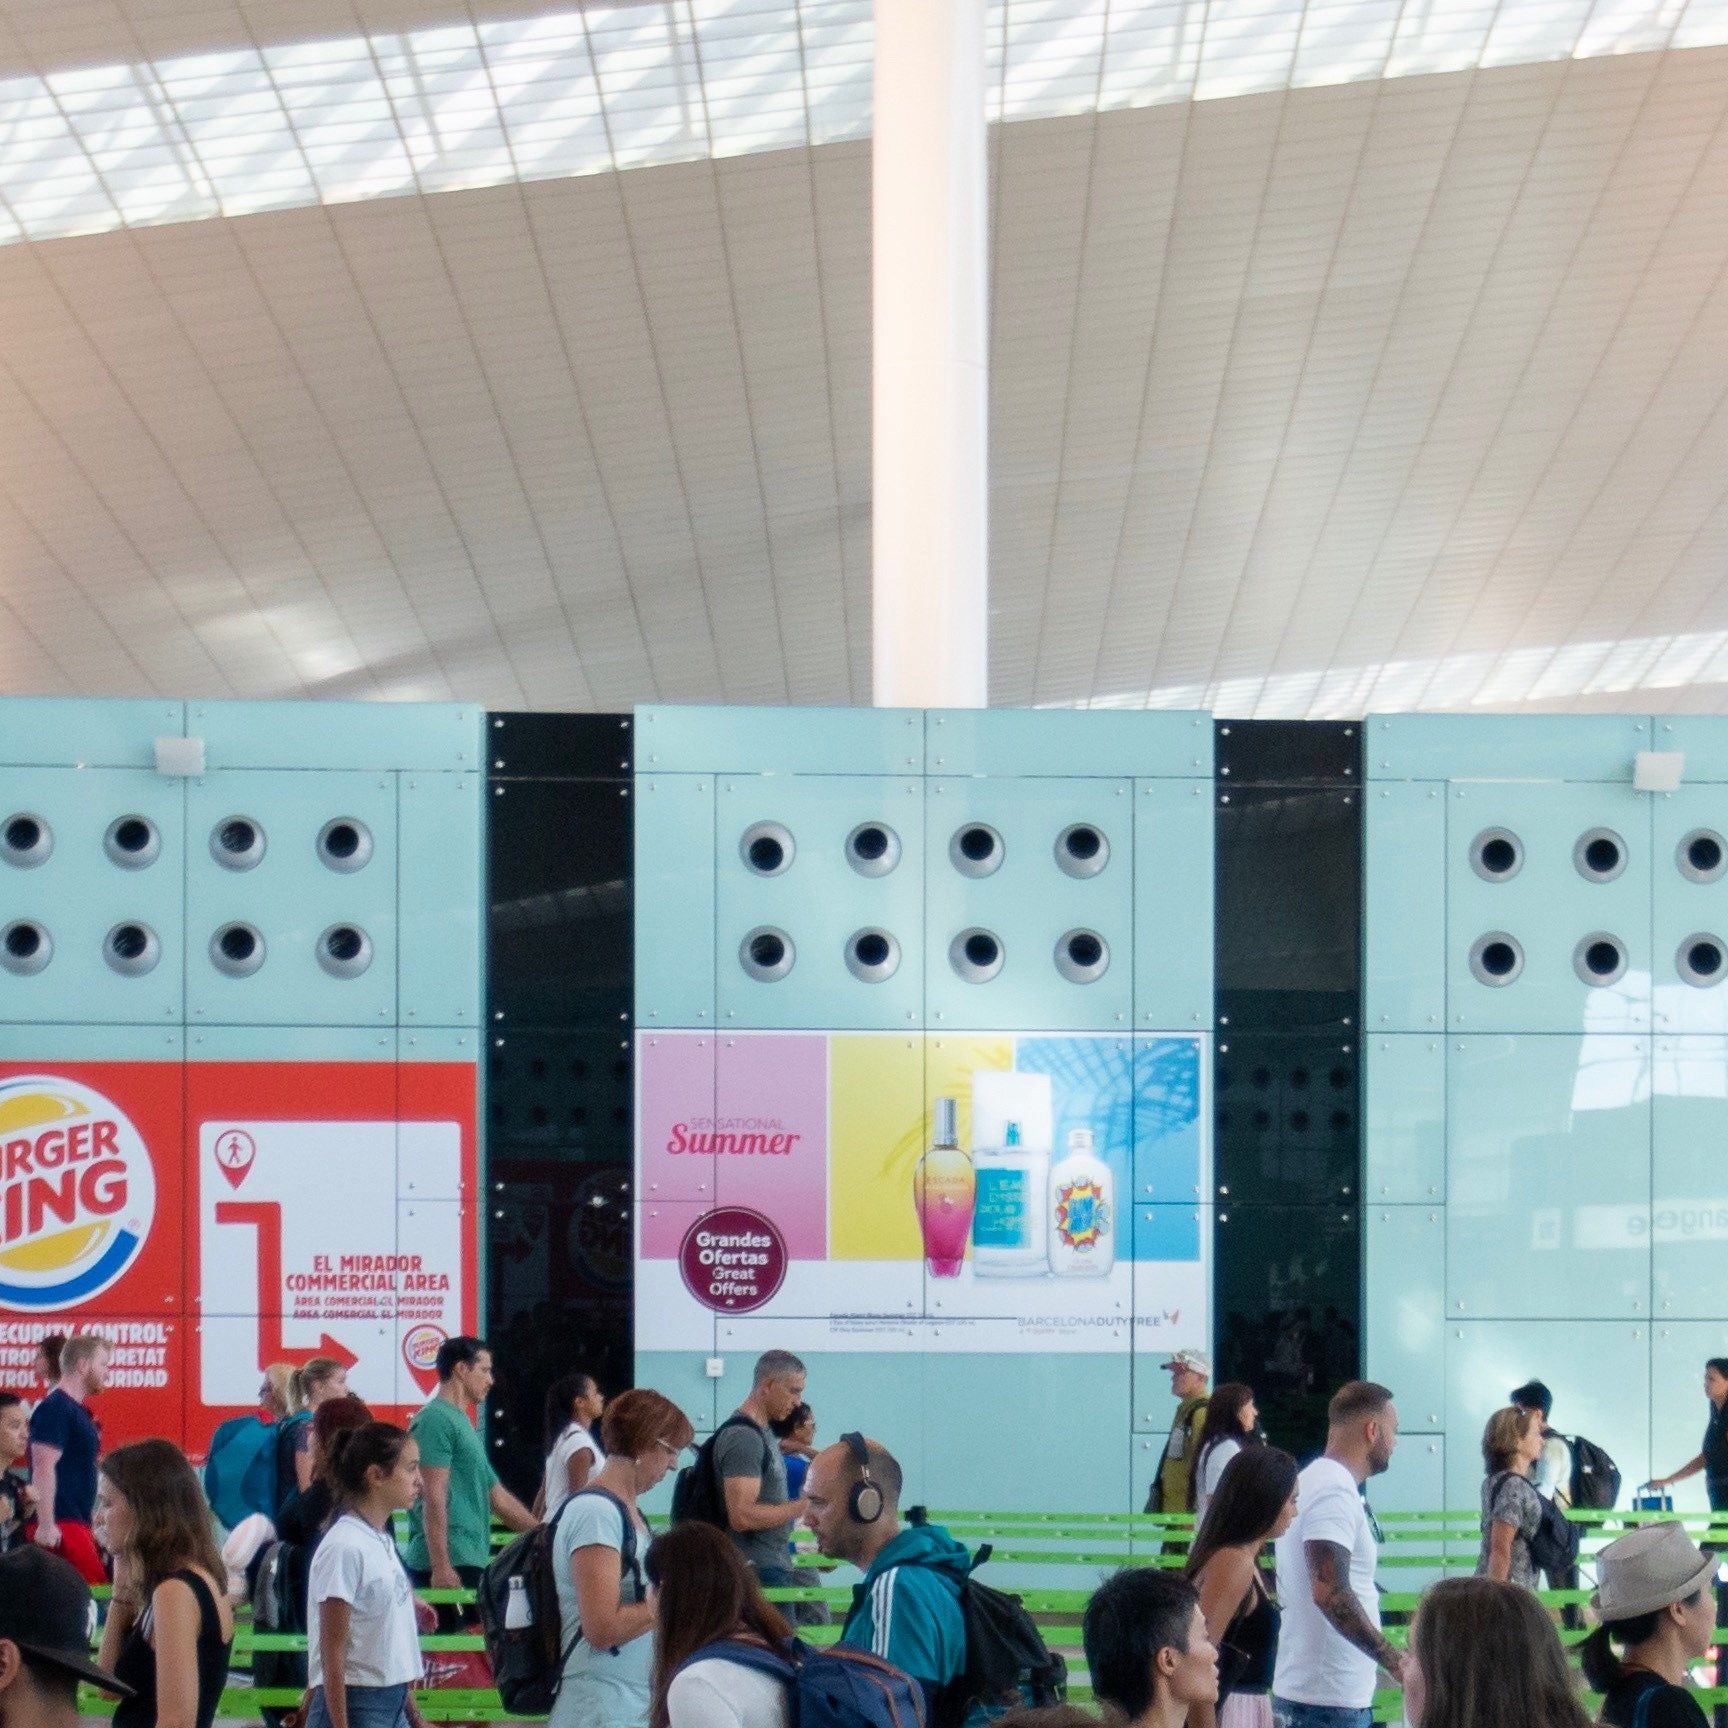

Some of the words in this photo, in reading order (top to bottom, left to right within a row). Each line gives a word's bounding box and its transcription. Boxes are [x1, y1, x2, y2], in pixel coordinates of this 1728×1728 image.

[690, 1117, 783, 1131] SENSATIONAL
[665, 1123, 801, 1156] Summer
[696, 1232, 771, 1248] Grandes
[313, 1255, 333, 1272] EL
[340, 1255, 423, 1272] MIRADOR
[699, 1249, 768, 1266] Ofertas
[712, 1267, 757, 1281] Great
[285, 1274, 398, 1292] COMMERCIAL
[403, 1274, 451, 1292] AREA
[709, 1282, 759, 1297] Offers
[325, 1296, 377, 1307] COMERCIAL
[397, 1296, 445, 1307] MIRADOR
[396, 1309, 443, 1320] MIRADOR
[80, 1323, 169, 1345] CONTROL
